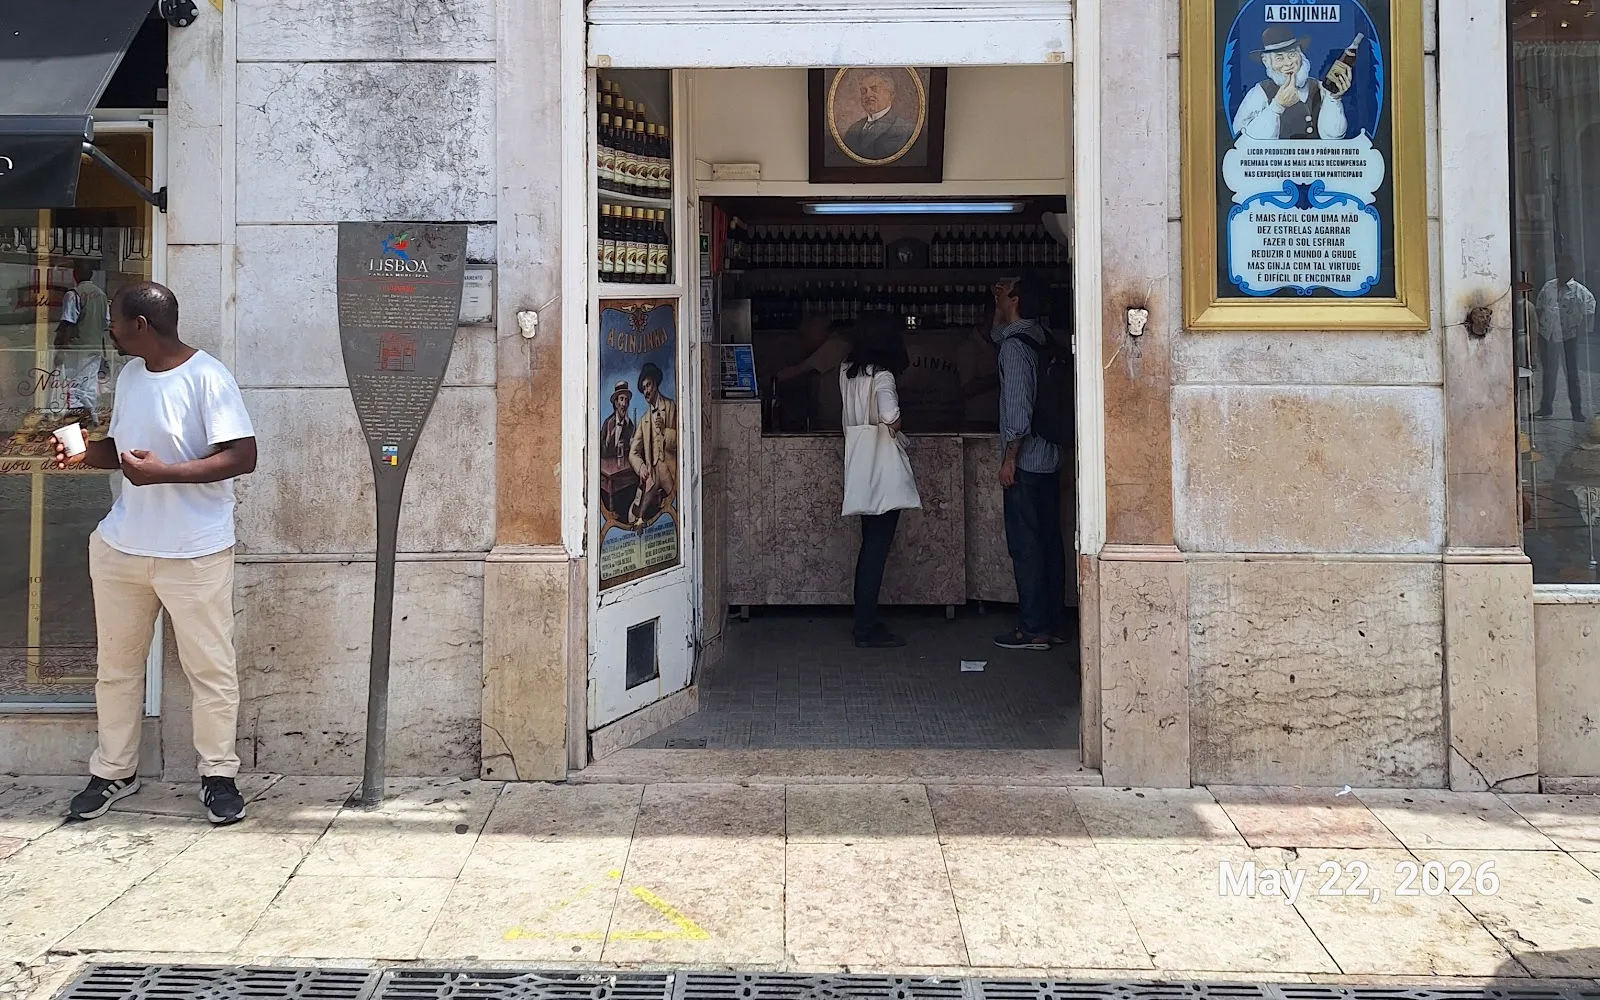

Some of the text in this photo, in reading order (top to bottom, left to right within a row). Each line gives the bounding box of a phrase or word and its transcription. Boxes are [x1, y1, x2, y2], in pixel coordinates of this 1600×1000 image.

[1266, 6, 1338, 22] A GINJINHA
[1247, 146, 1360, 156] LICOR PRODUZIDO COM O PRÓPRIO FRUTO
[1240, 159, 1367, 167] PREMIADA COM AS MAIS ALTAS RECOMPENSAS
[1244, 169, 1363, 180] NAS EXPOSIÇÕES EM QUE TEM PARTICIPADO
[1249, 212, 1359, 223] É MAIS FÁCIL COM UMA MÃO
[1257, 225, 1351, 235] DEZ ESTRELAS AGARRAR
[1263, 237, 1345, 247] FAZER O SOL ESFRIAR
[1251, 249, 1357, 259] REDUZIR O MUNDO A GRUDE
[368, 258, 429, 273] LISBOA
[1247, 261, 1361, 271] MAS GINJA COM TAL VIRTUDE
[1257, 272, 1352, 283] É DIFÍCIL DE ENCONTRAR
